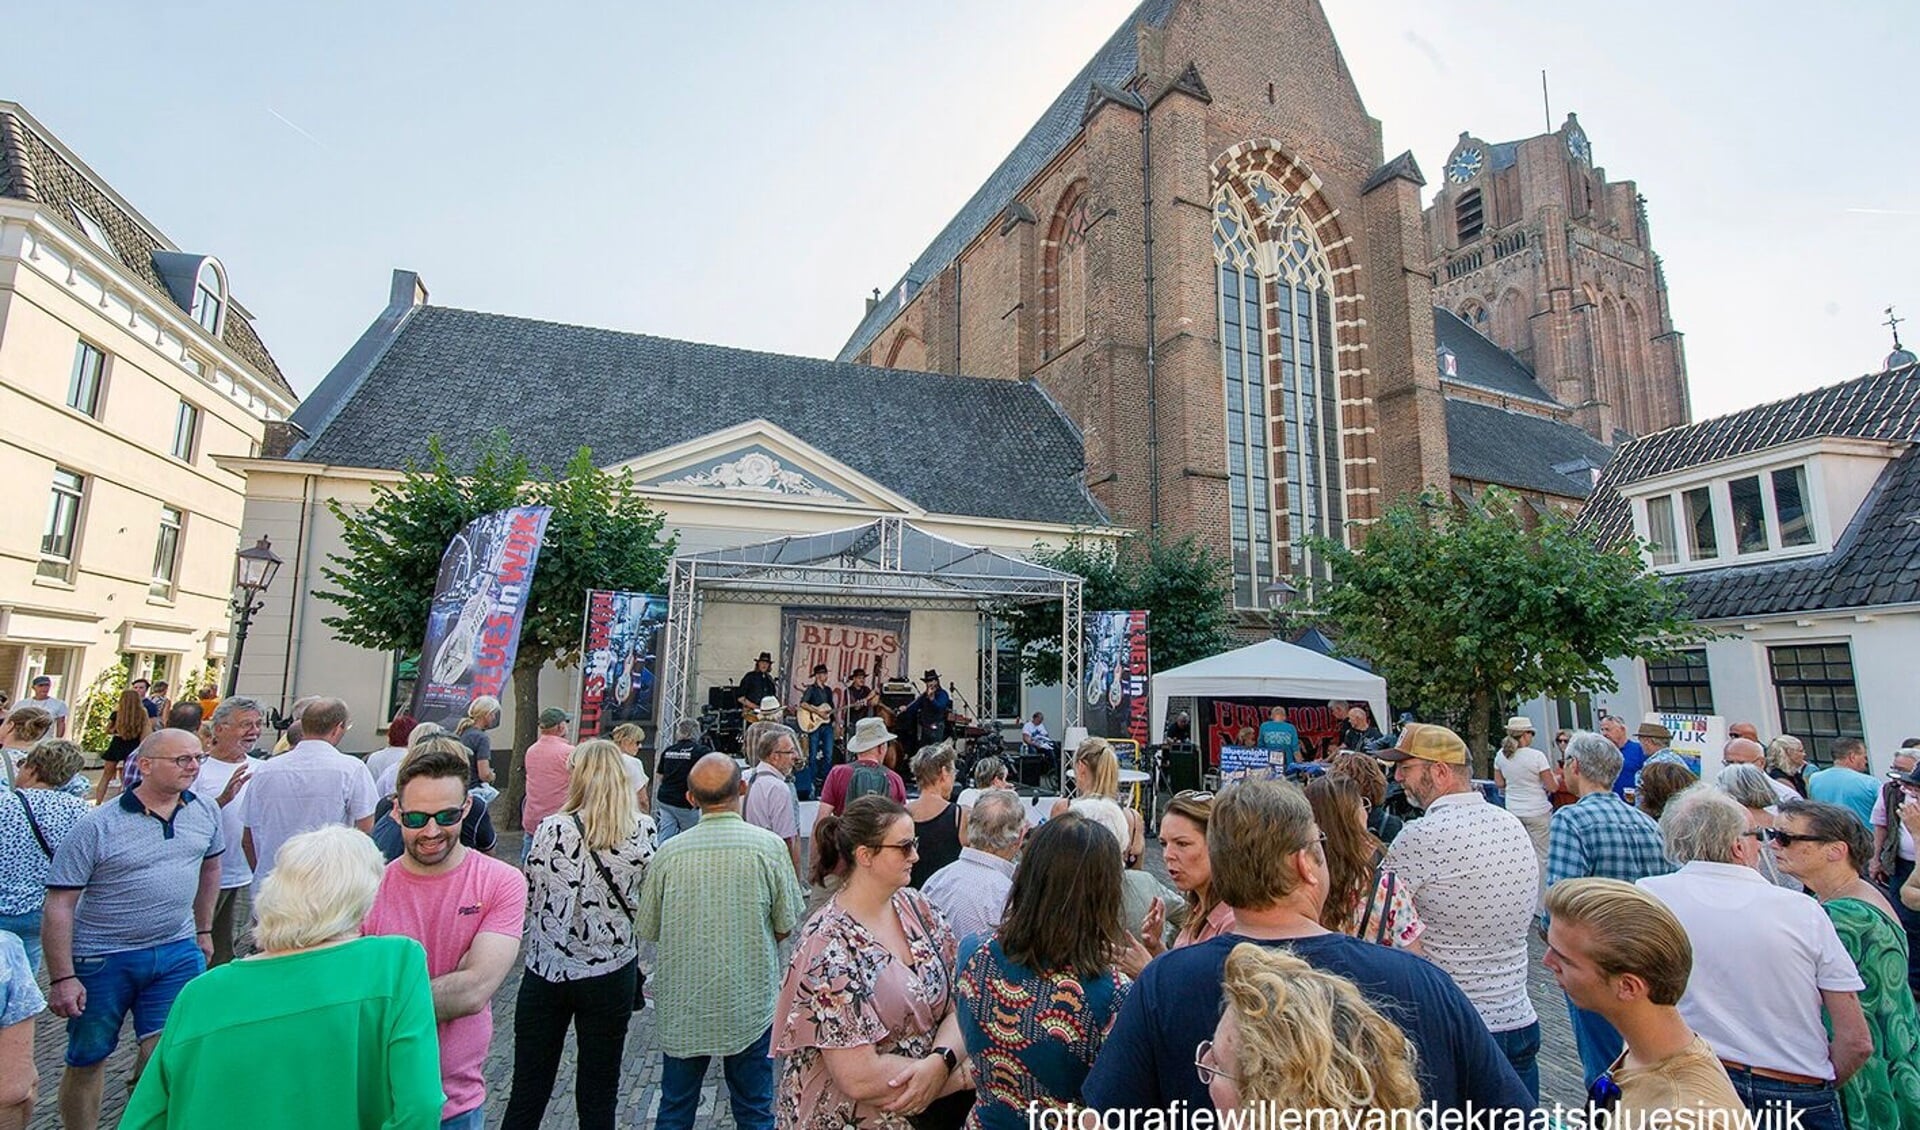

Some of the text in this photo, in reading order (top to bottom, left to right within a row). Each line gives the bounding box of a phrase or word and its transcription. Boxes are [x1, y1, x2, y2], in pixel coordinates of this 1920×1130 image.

[472, 514, 540, 700] BLUES in WIJK
[801, 624, 897, 653] BLUES
[579, 675, 605, 743] LUES
[1131, 674, 1148, 696] in
